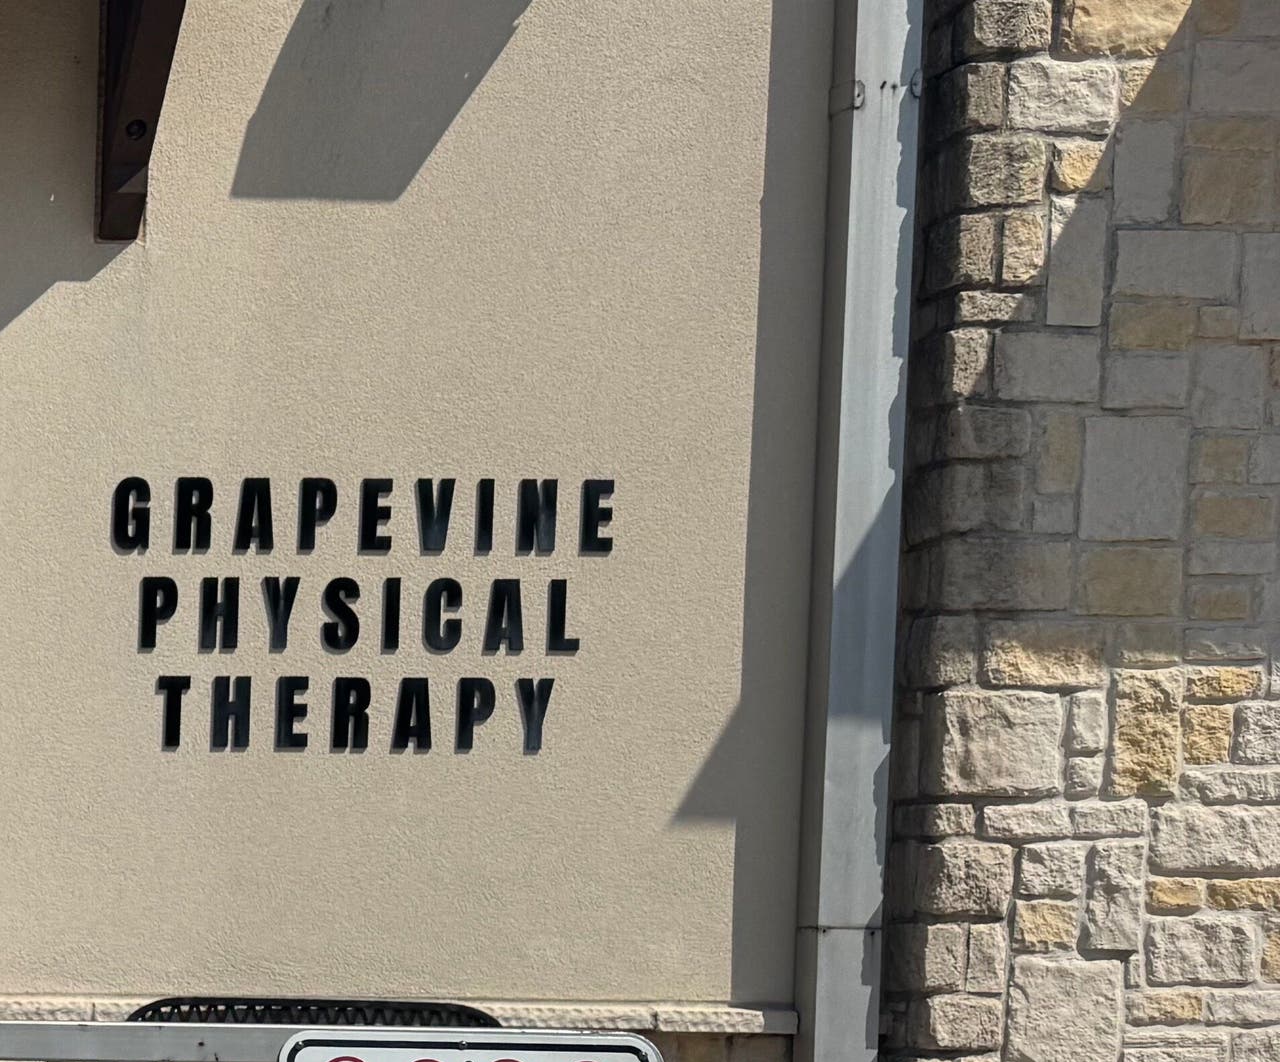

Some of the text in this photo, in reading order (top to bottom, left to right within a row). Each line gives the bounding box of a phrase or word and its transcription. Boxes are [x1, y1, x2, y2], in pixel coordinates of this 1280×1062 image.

[110, 476, 616, 554] GRAPEVINE
[138, 575, 581, 655] PHYSICAL
[155, 675, 556, 754] THERAPY
